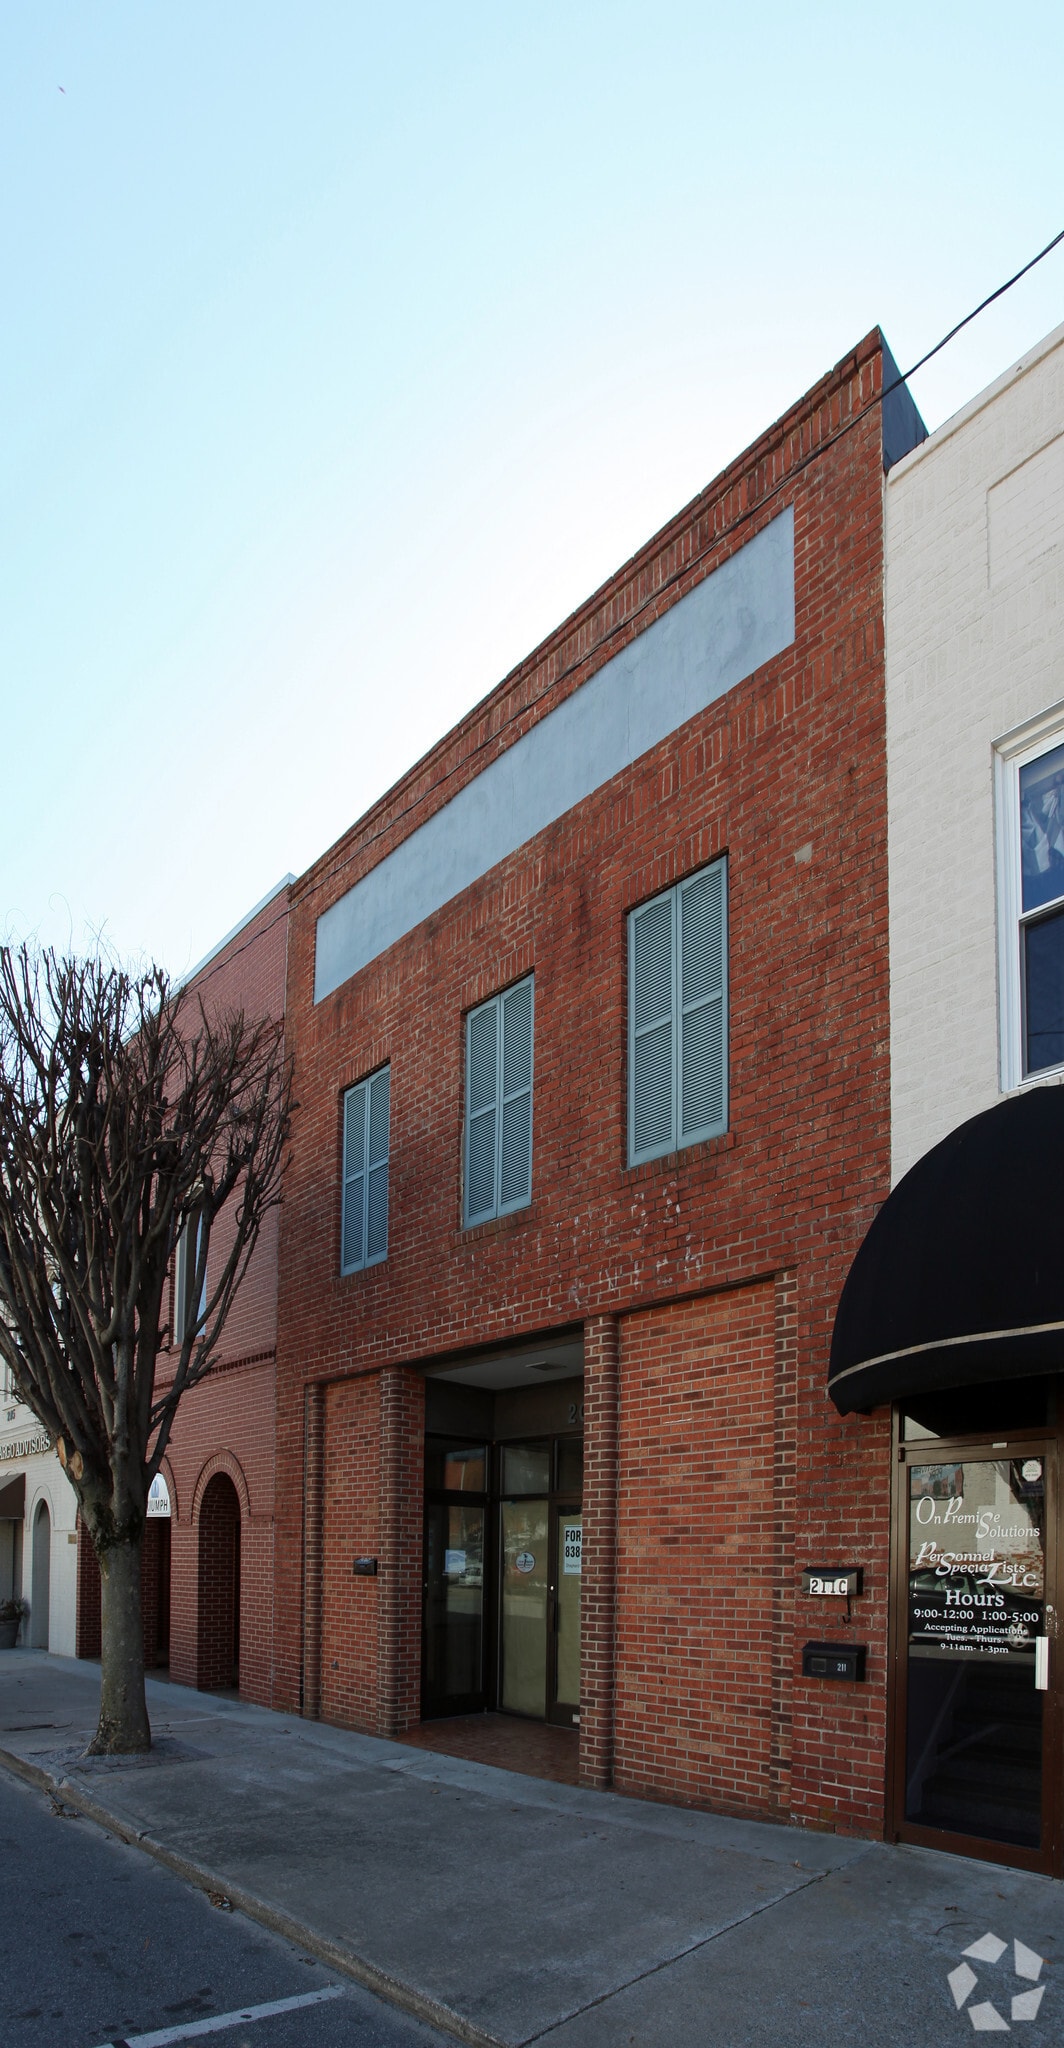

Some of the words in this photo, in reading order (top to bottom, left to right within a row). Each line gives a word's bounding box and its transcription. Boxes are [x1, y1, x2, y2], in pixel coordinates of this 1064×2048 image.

[15, 1434, 51, 1457] ADVISORS
[916, 1496, 941, 1524] On
[975, 1511, 1040, 1539] Solutions
[565, 1530, 581, 1542] FOR
[945, 1589, 1005, 1607] Hours
[913, 1608, 974, 1620] 9:00-12:00
[981, 1610, 1040, 1623] 1:00-5:00
[924, 1623, 968, 1634] Accepting
[969, 1625, 1028, 1635] Applications
[837, 1662, 847, 1672] 211
